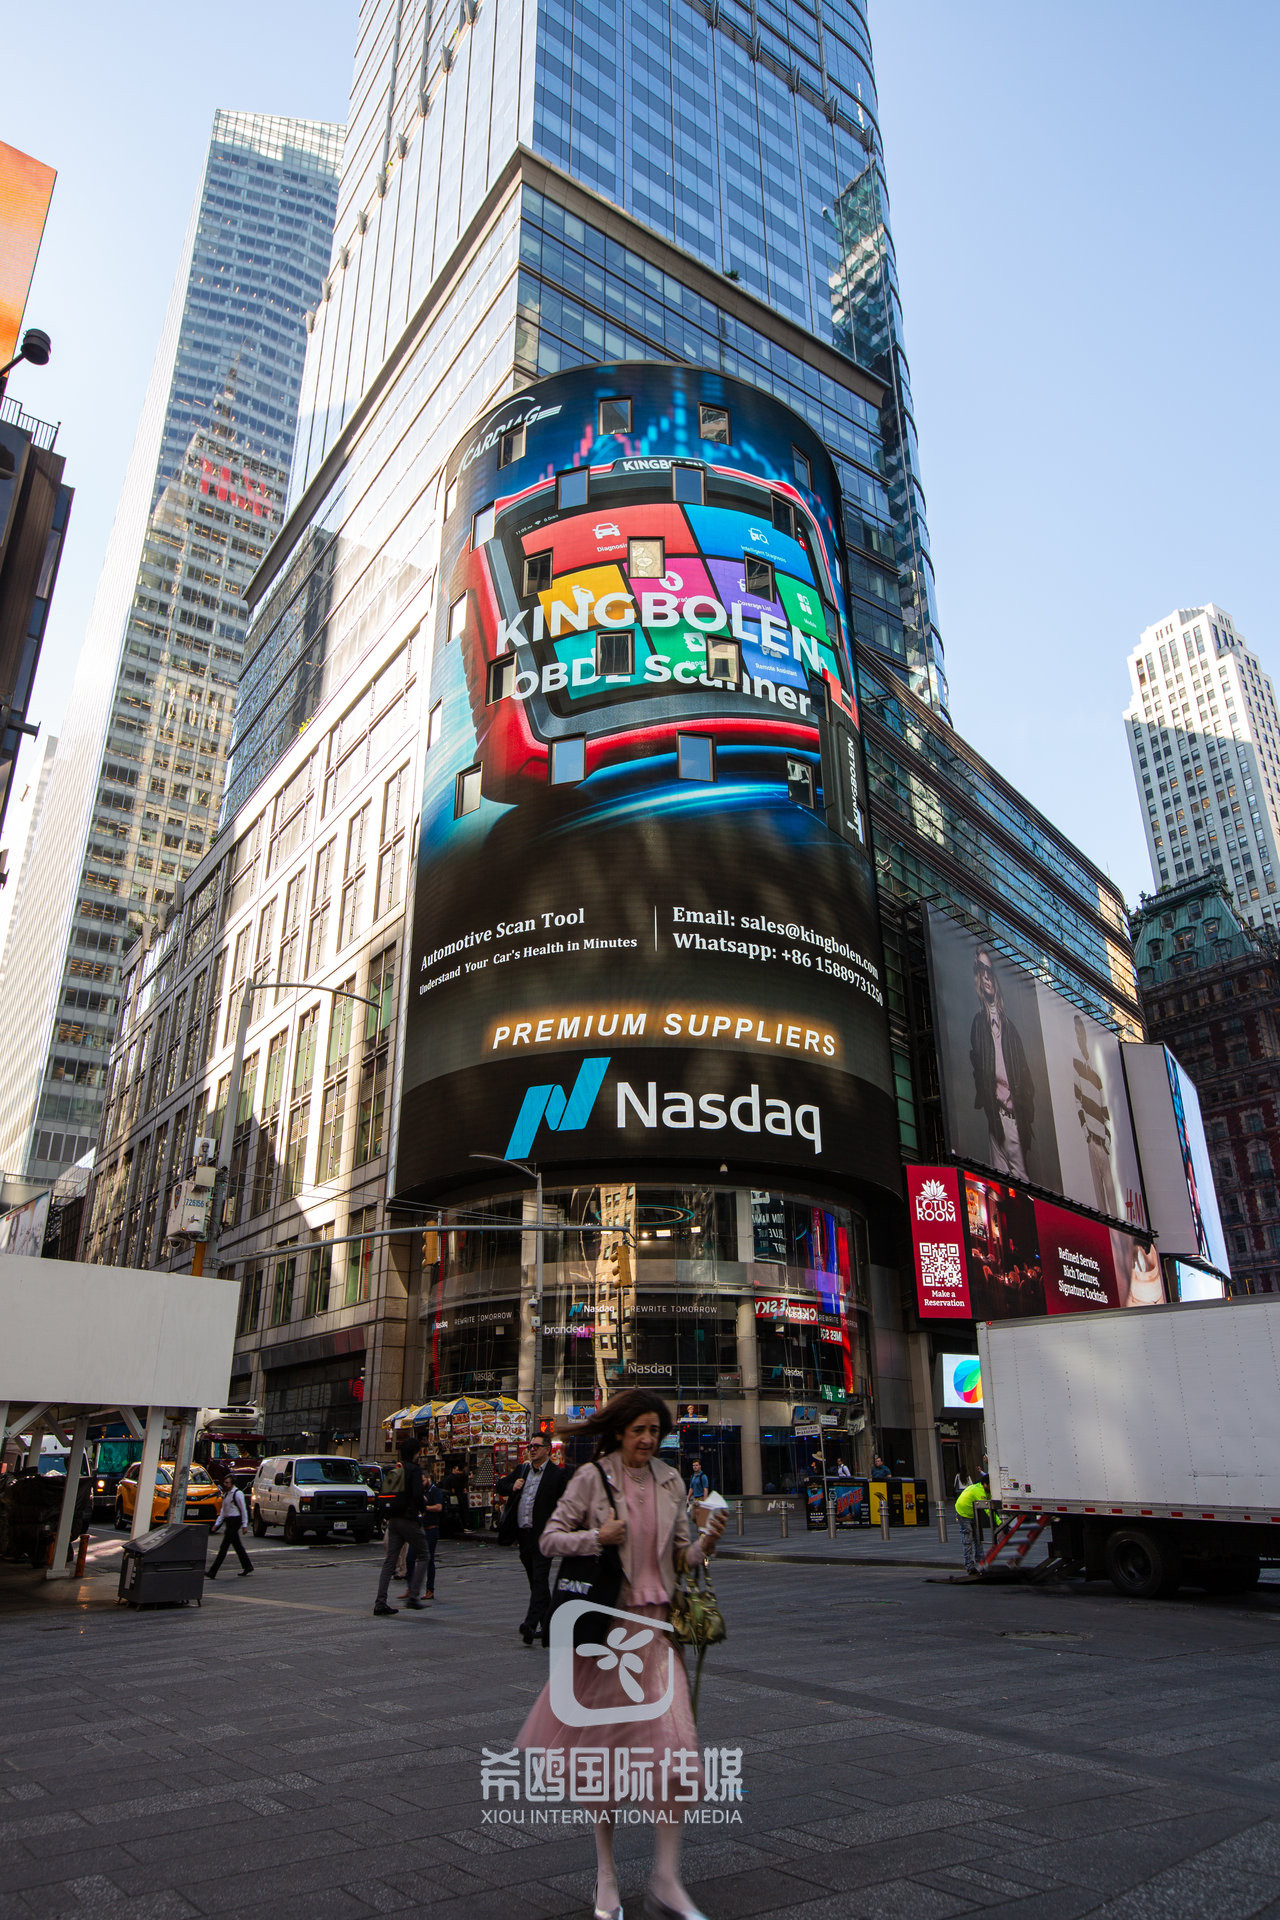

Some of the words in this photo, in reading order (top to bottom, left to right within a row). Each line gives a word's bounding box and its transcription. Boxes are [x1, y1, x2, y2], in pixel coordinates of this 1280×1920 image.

[623, 459, 703, 472] KINGB
[496, 592, 819, 674] KINGBOLEN
[510, 656, 631, 701] OBD
[420, 929, 492, 972] Automotive
[496, 918, 536, 939] Scan
[541, 907, 585, 929] Tool
[672, 906, 736, 927] Email:
[740, 914, 879, 981] sales@kingbolen.com
[419, 966, 461, 996] Understand
[464, 957, 489, 974] Your
[493, 949, 521, 965] Car's
[523, 940, 564, 959] Health
[567, 940, 580, 952] in
[583, 937, 638, 950] Minutes
[672, 932, 777, 962] Whatsapp:
[781, 949, 812, 968] +86
[815, 956, 884, 1007] 15889731250
[492, 1013, 648, 1050] PREMIUM
[662, 1013, 836, 1057] SUPPLIERS
[616, 1081, 822, 1155] Nasdaq
[915, 1199, 956, 1213] LOTUS
[916, 1208, 957, 1222] ROOM
[1057, 1246, 1080, 1265] Refined
[1079, 1254, 1101, 1272] Service,
[1063, 1264, 1077, 1280] Rich
[1075, 1268, 1100, 1287] Textures,
[924, 1298, 965, 1307] Reservation
[931, 1289, 951, 1298] Make
[1058, 1279, 1086, 1297] Signature
[1085, 1287, 1109, 1304] Cocktails
[583, 1304, 615, 1315] Nasdaq
[629, 1305, 668, 1314] REWRITE
[670, 1305, 718, 1314] TOMORROW
[627, 1362, 673, 1377] Nasdaq
